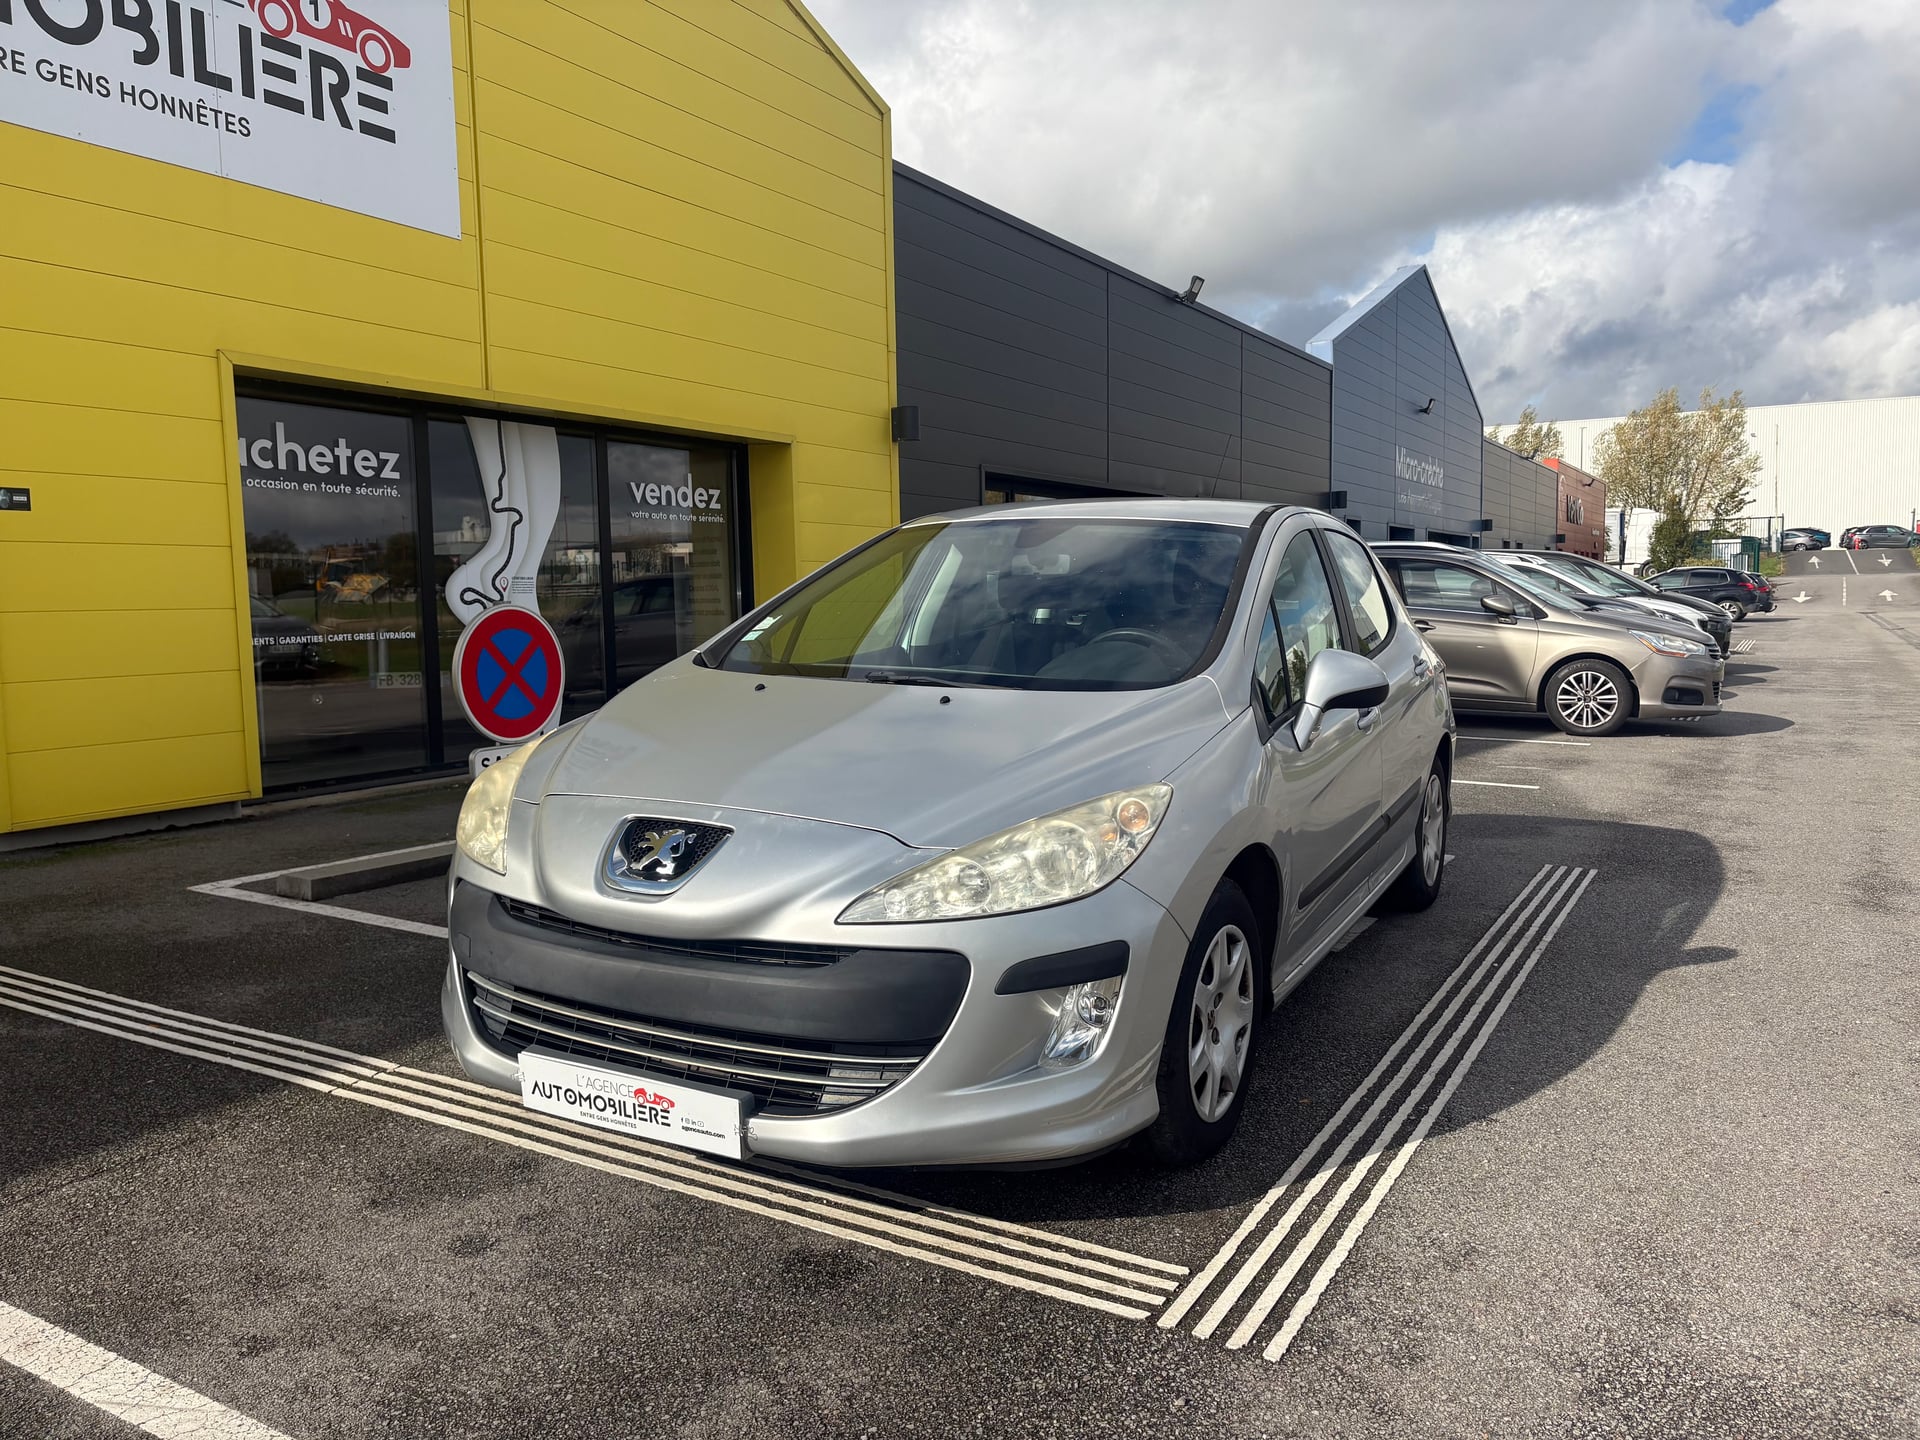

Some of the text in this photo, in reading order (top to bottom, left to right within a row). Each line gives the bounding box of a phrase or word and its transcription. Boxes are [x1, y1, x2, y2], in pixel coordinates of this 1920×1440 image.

[0, 0, 396, 144] OBILIERE
[35, 59, 111, 98] GENS
[119, 81, 251, 137] HONNÊTES
[246, 477, 401, 498] occasion en toute sécurité.
[629, 472, 721, 509] vendez
[630, 510, 650, 519] votre
[651, 512, 668, 521] auto
[680, 513, 697, 522] toute
[278, 634, 324, 645] GARANTIES
[327, 633, 352, 642] CARTE
[353, 632, 375, 641] GRISE
[379, 631, 416, 640] LIVRAISON
[576, 1073, 635, 1099] L'AGENCE
[580, 1110, 596, 1120] ENTRE
[596, 1115, 610, 1123] GENS
